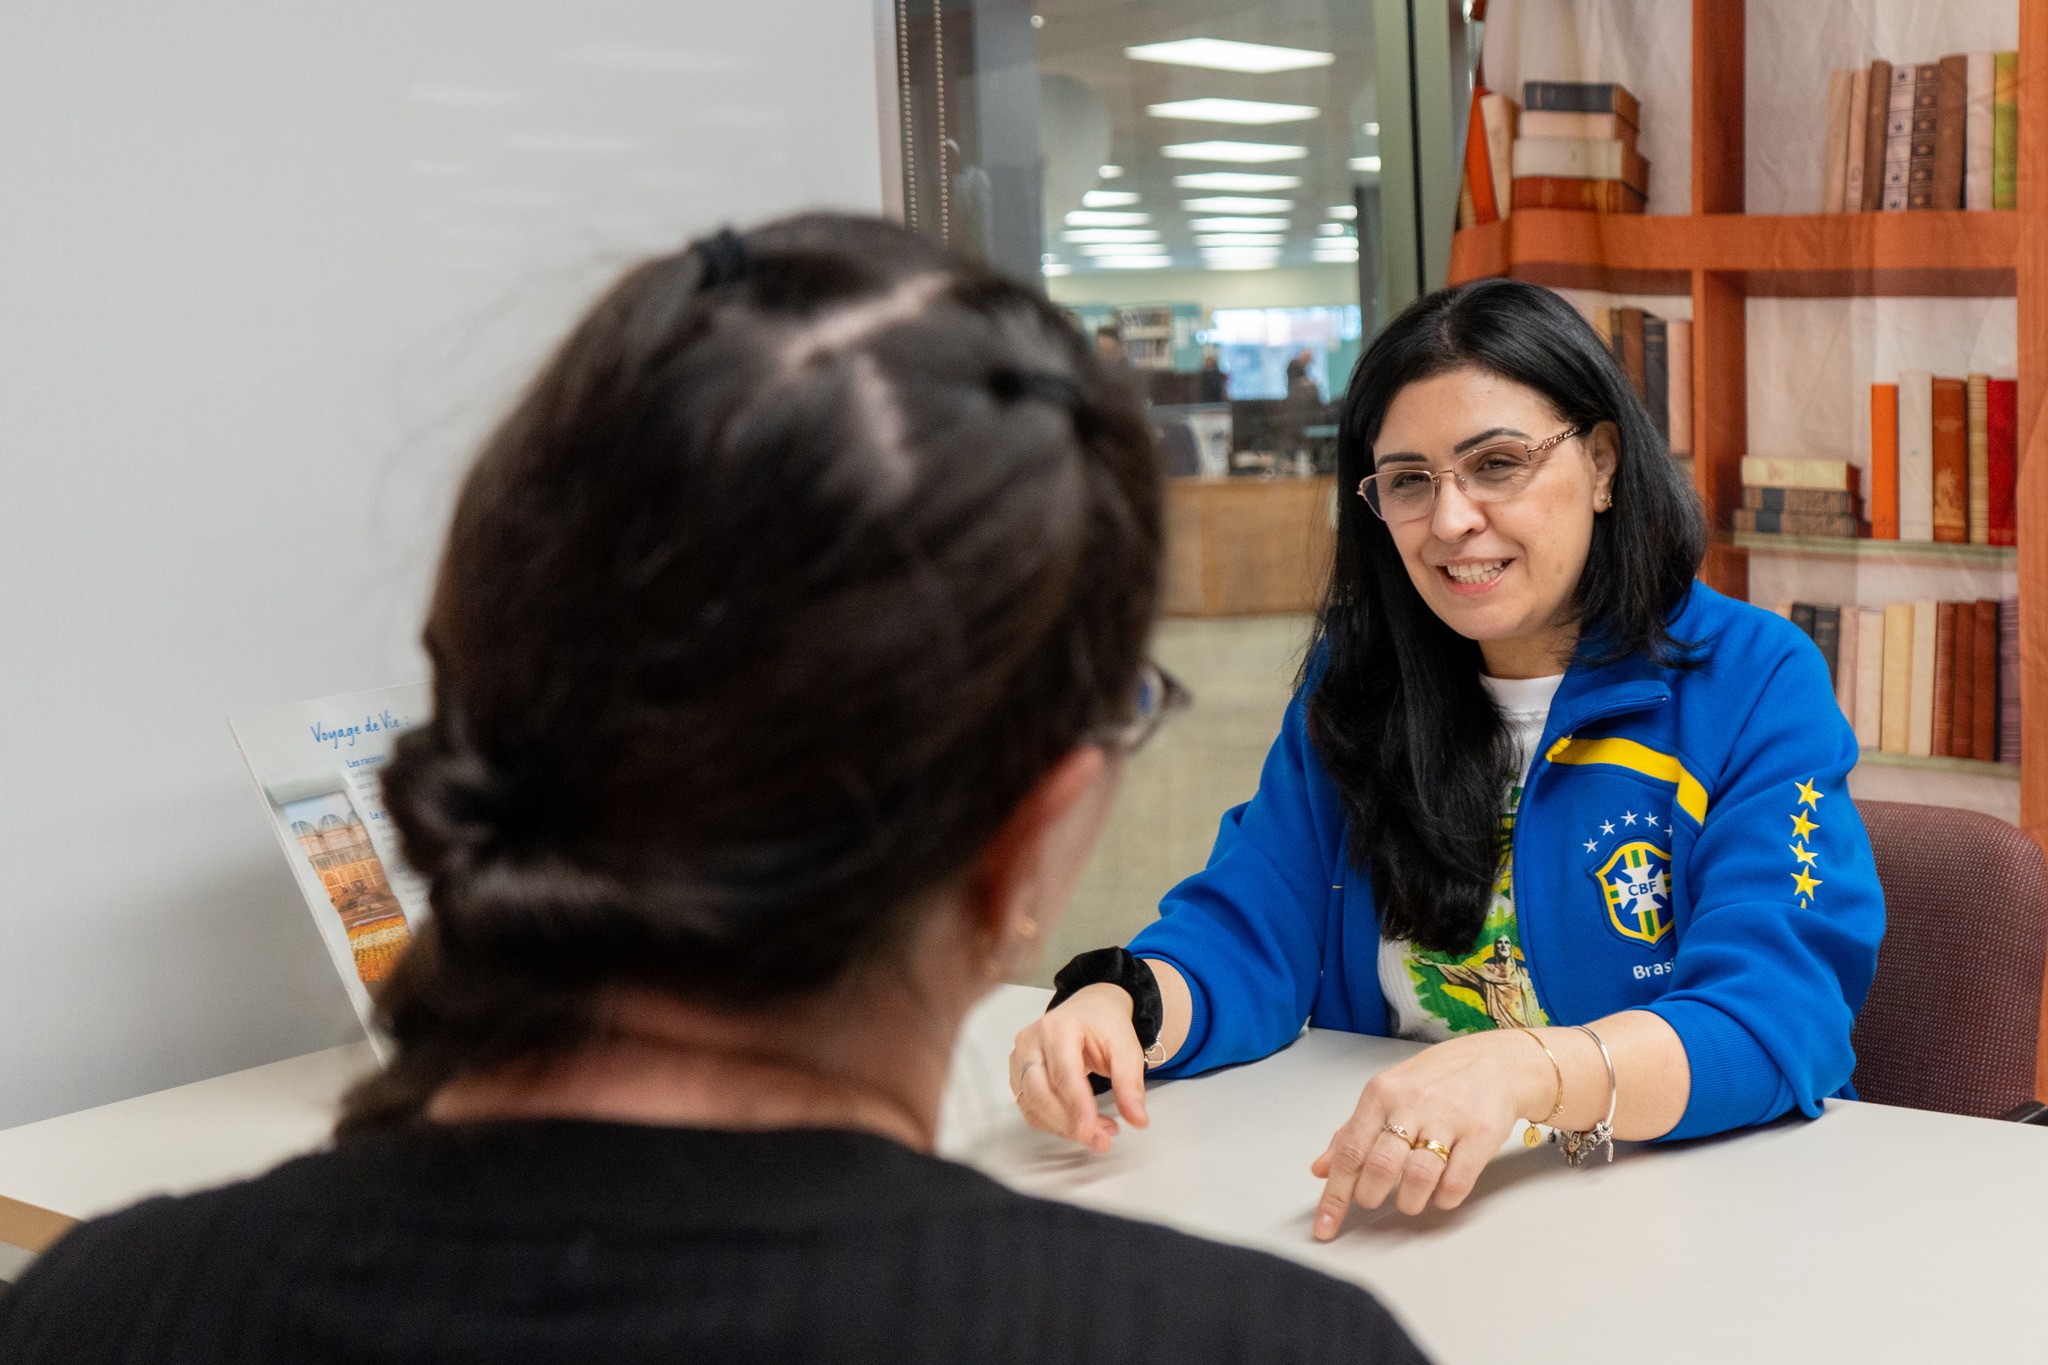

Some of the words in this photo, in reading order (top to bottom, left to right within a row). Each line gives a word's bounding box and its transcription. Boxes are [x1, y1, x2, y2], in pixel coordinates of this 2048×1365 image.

[310, 722, 361, 749] Voyage
[365, 715, 380, 732] de
[379, 709, 400, 729] Vie
[345, 759, 360, 768] Les
[1628, 880, 1657, 896] CBF
[1632, 957, 1675, 980] Brasi
